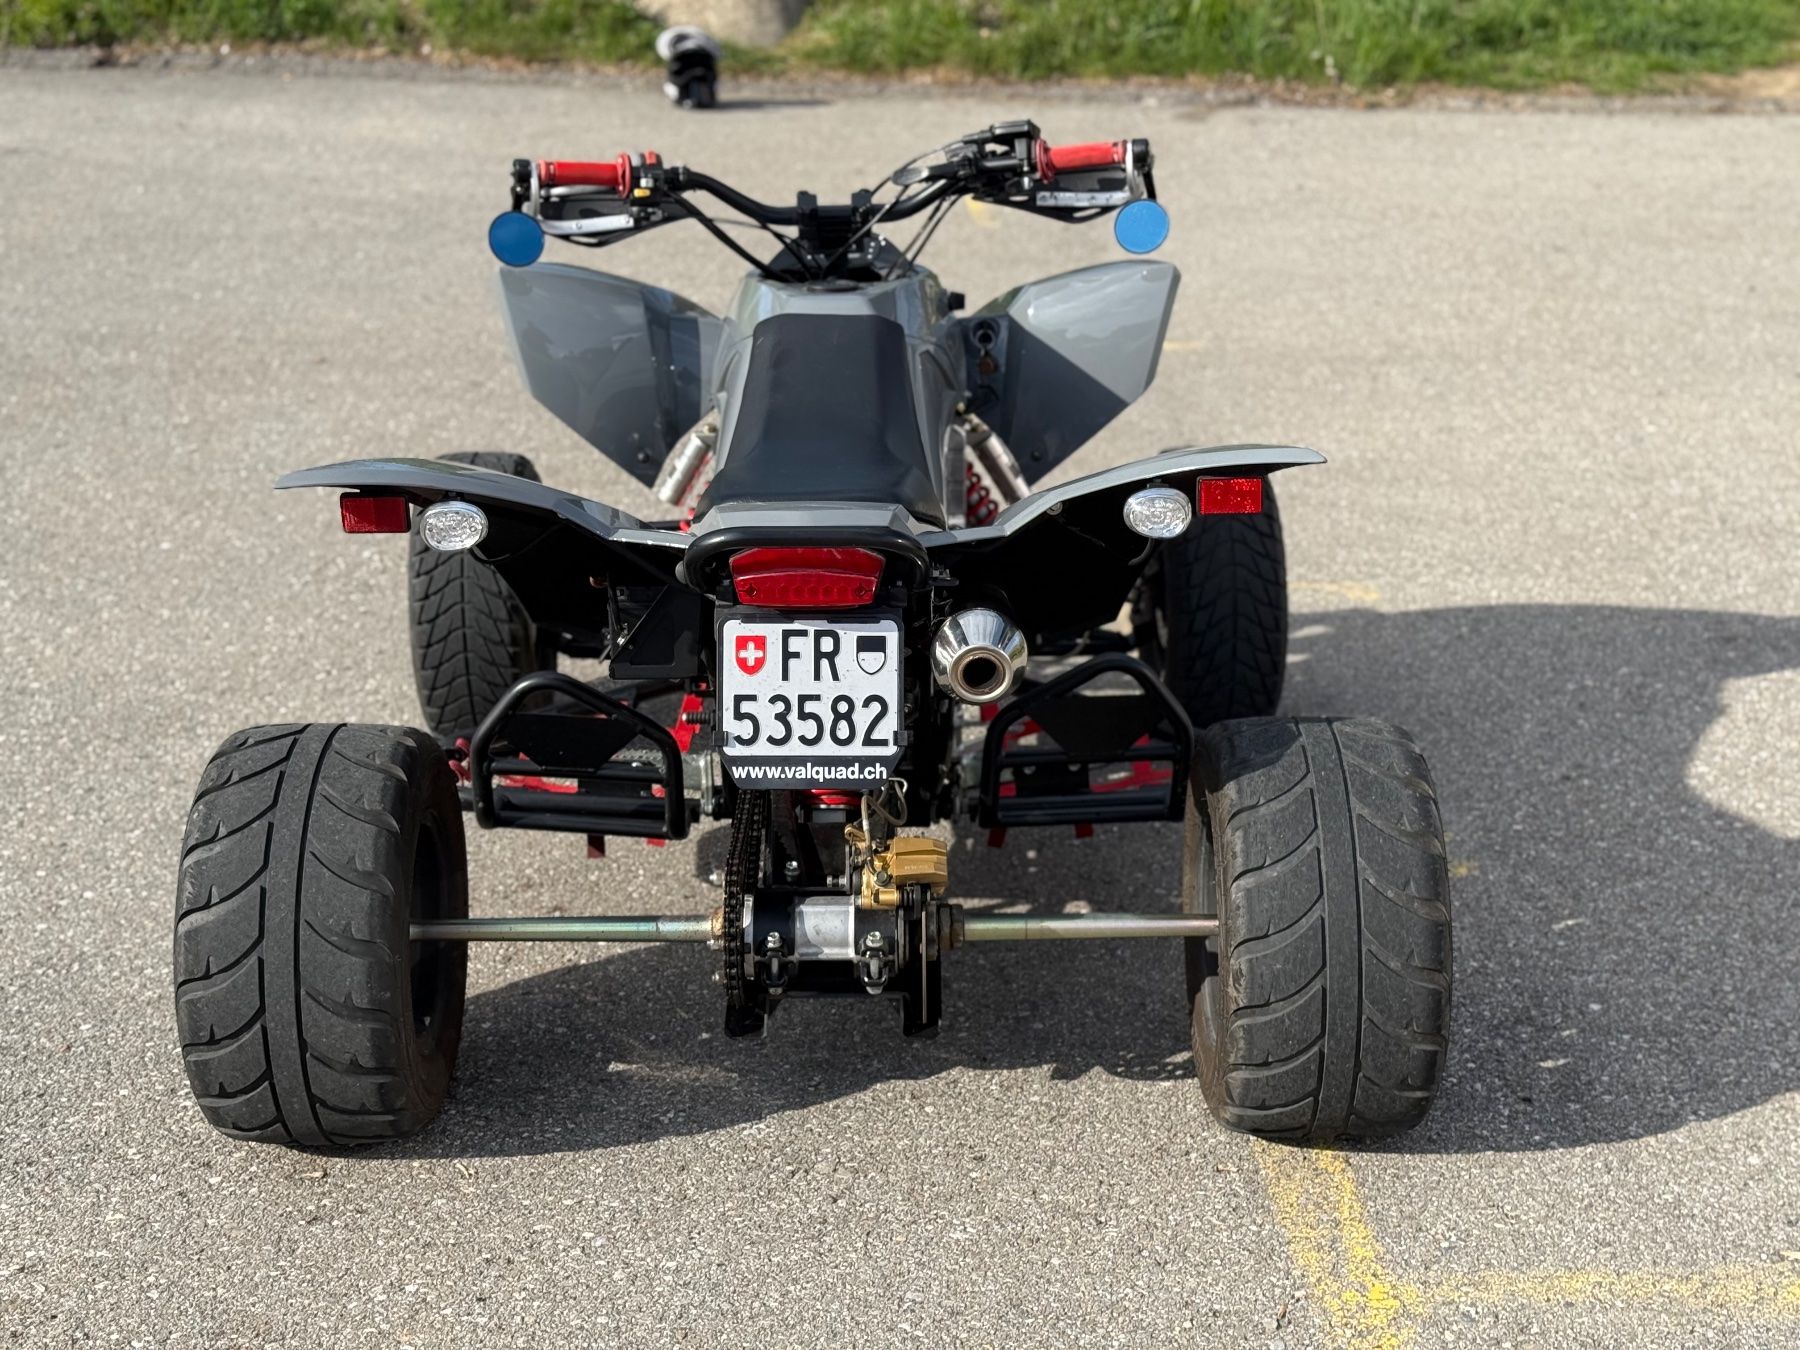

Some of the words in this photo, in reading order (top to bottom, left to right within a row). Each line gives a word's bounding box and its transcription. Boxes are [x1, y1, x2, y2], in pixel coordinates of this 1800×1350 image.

[781, 629, 841, 682] FR
[733, 694, 889, 747] 53582
[731, 762, 887, 782] www.valquad.ch
